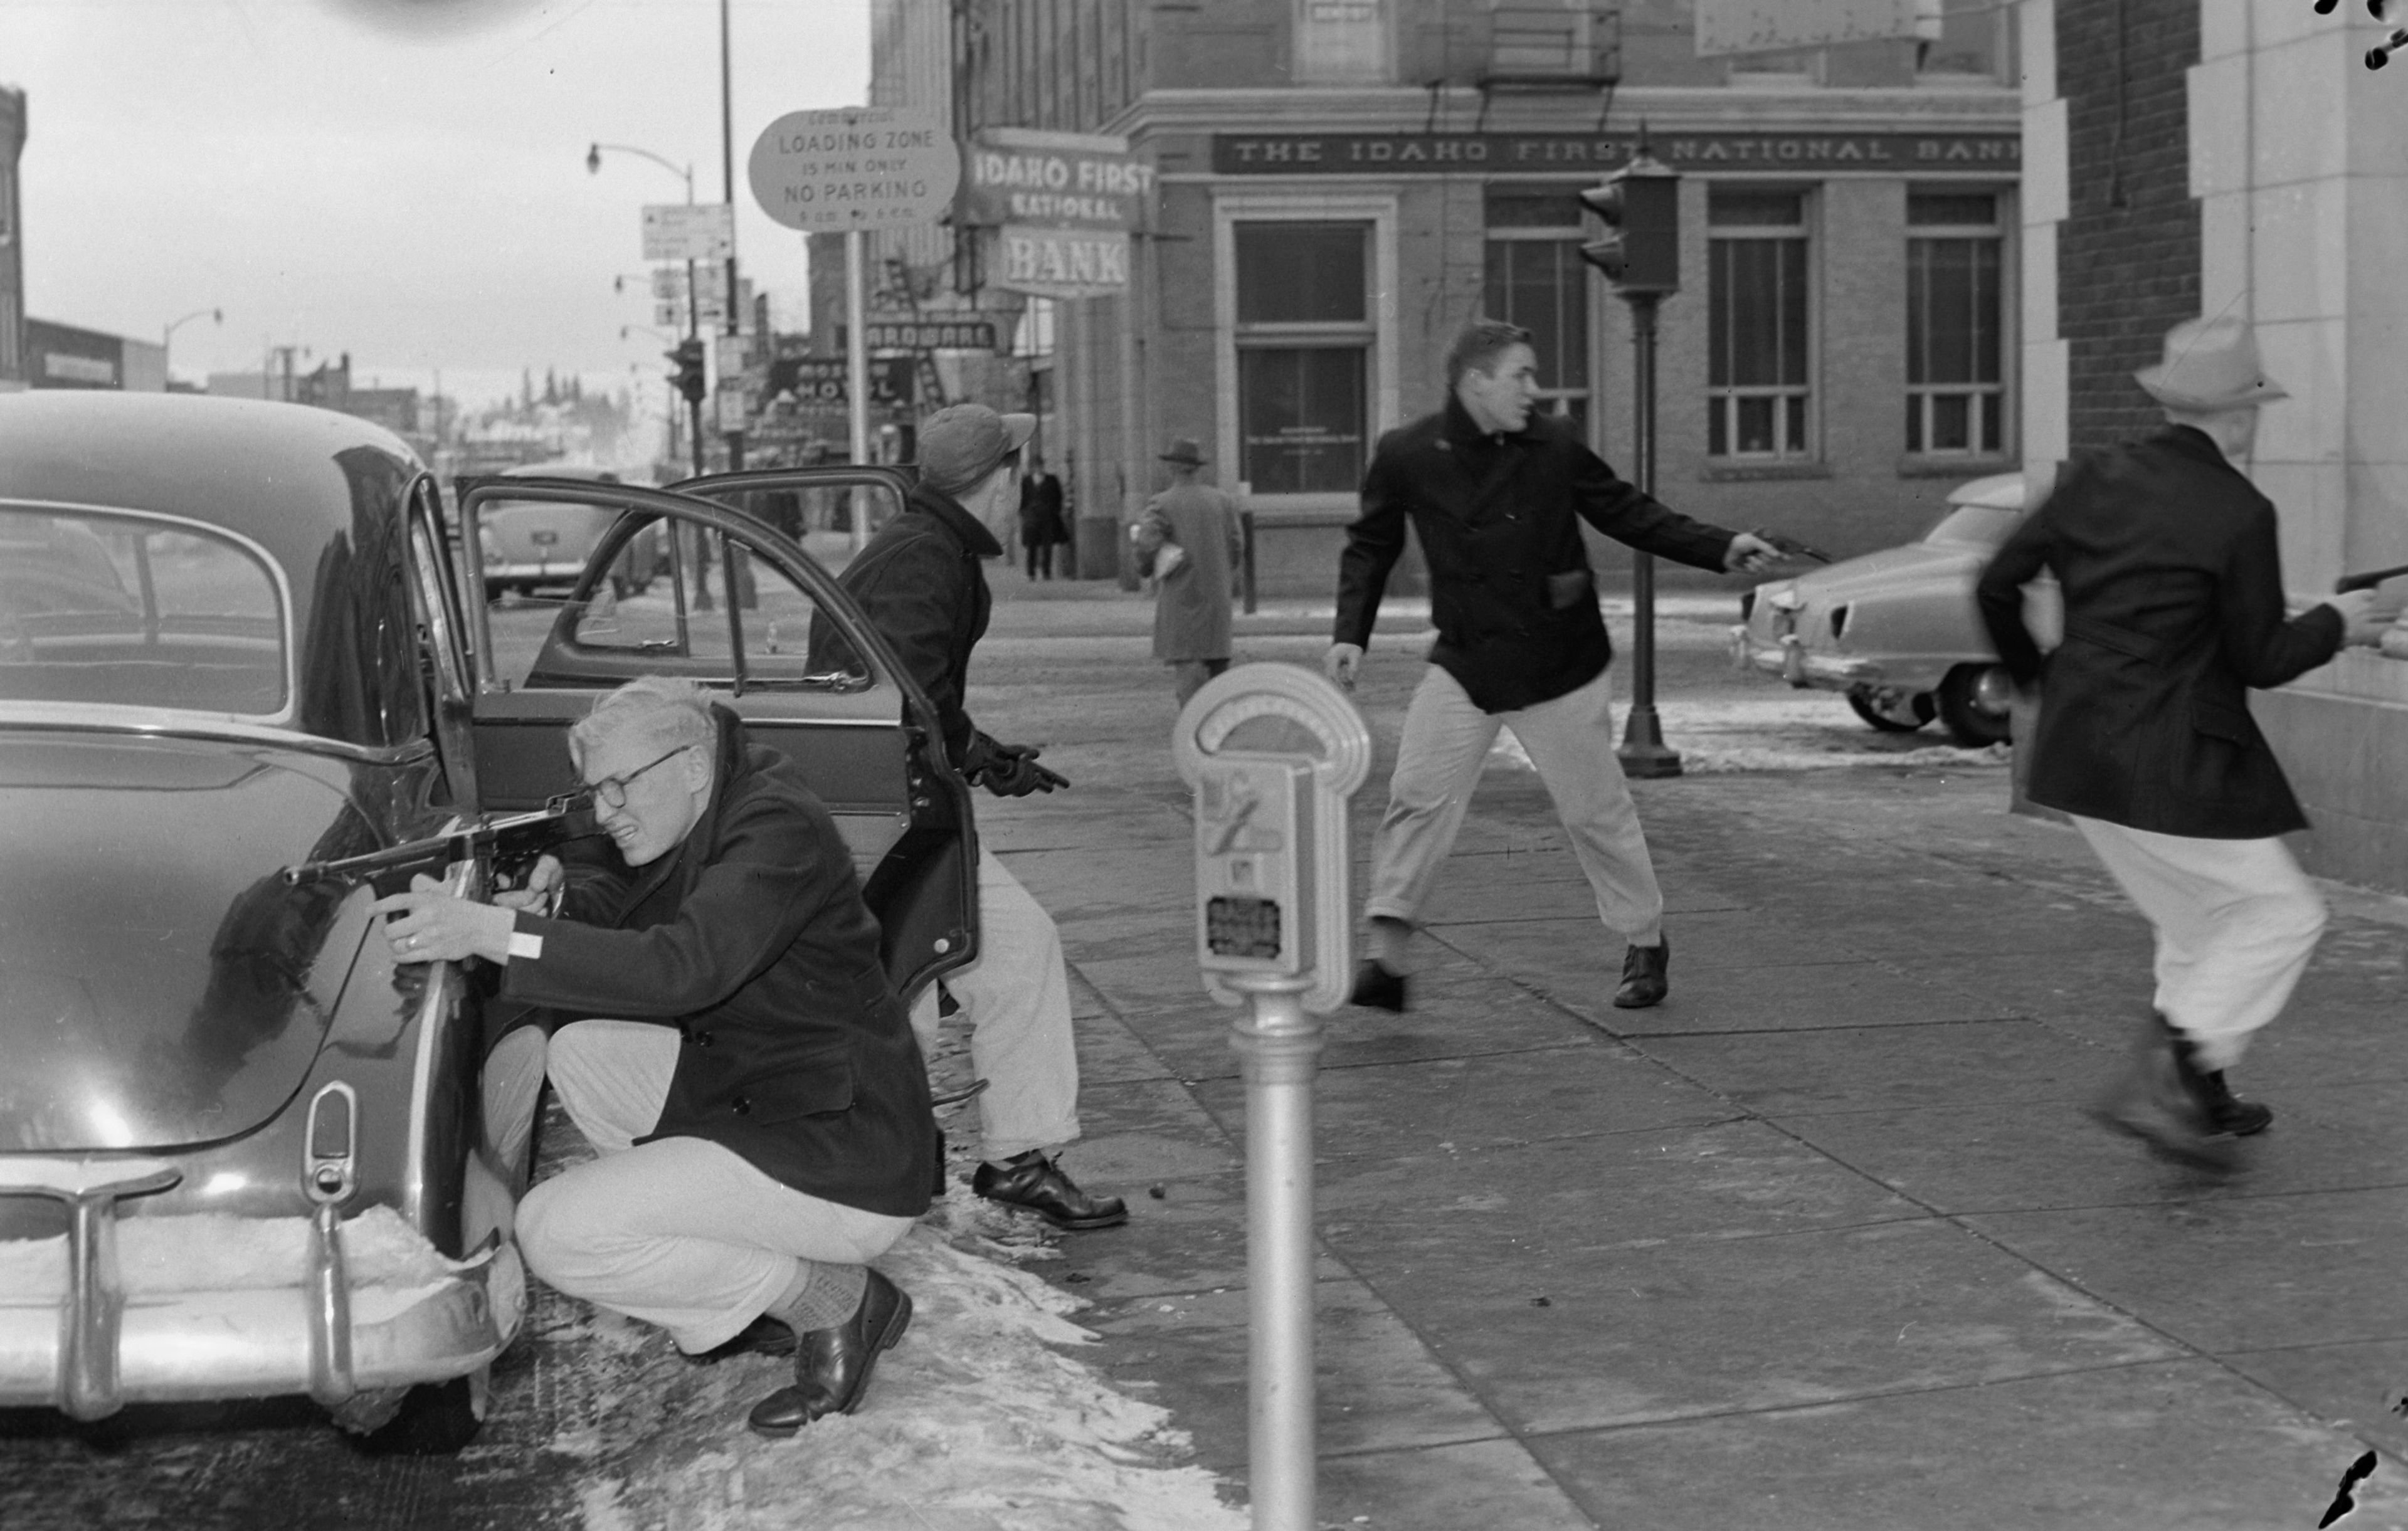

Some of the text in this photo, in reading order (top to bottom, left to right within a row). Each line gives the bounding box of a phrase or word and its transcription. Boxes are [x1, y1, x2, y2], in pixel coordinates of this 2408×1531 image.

[779, 130, 934, 154] LOADING ZONE
[1237, 143, 1321, 162] THE
[1351, 142, 1487, 161] IDAHO
[1517, 142, 1642, 160] FIRST
[1672, 140, 1891, 159] NATIONAL
[802, 159, 907, 176] 15 MIN ONLY
[973, 152, 1154, 196] IDAHO FIRST
[784, 181, 927, 203] NO PARKING
[1009, 236, 1126, 282] BANK
